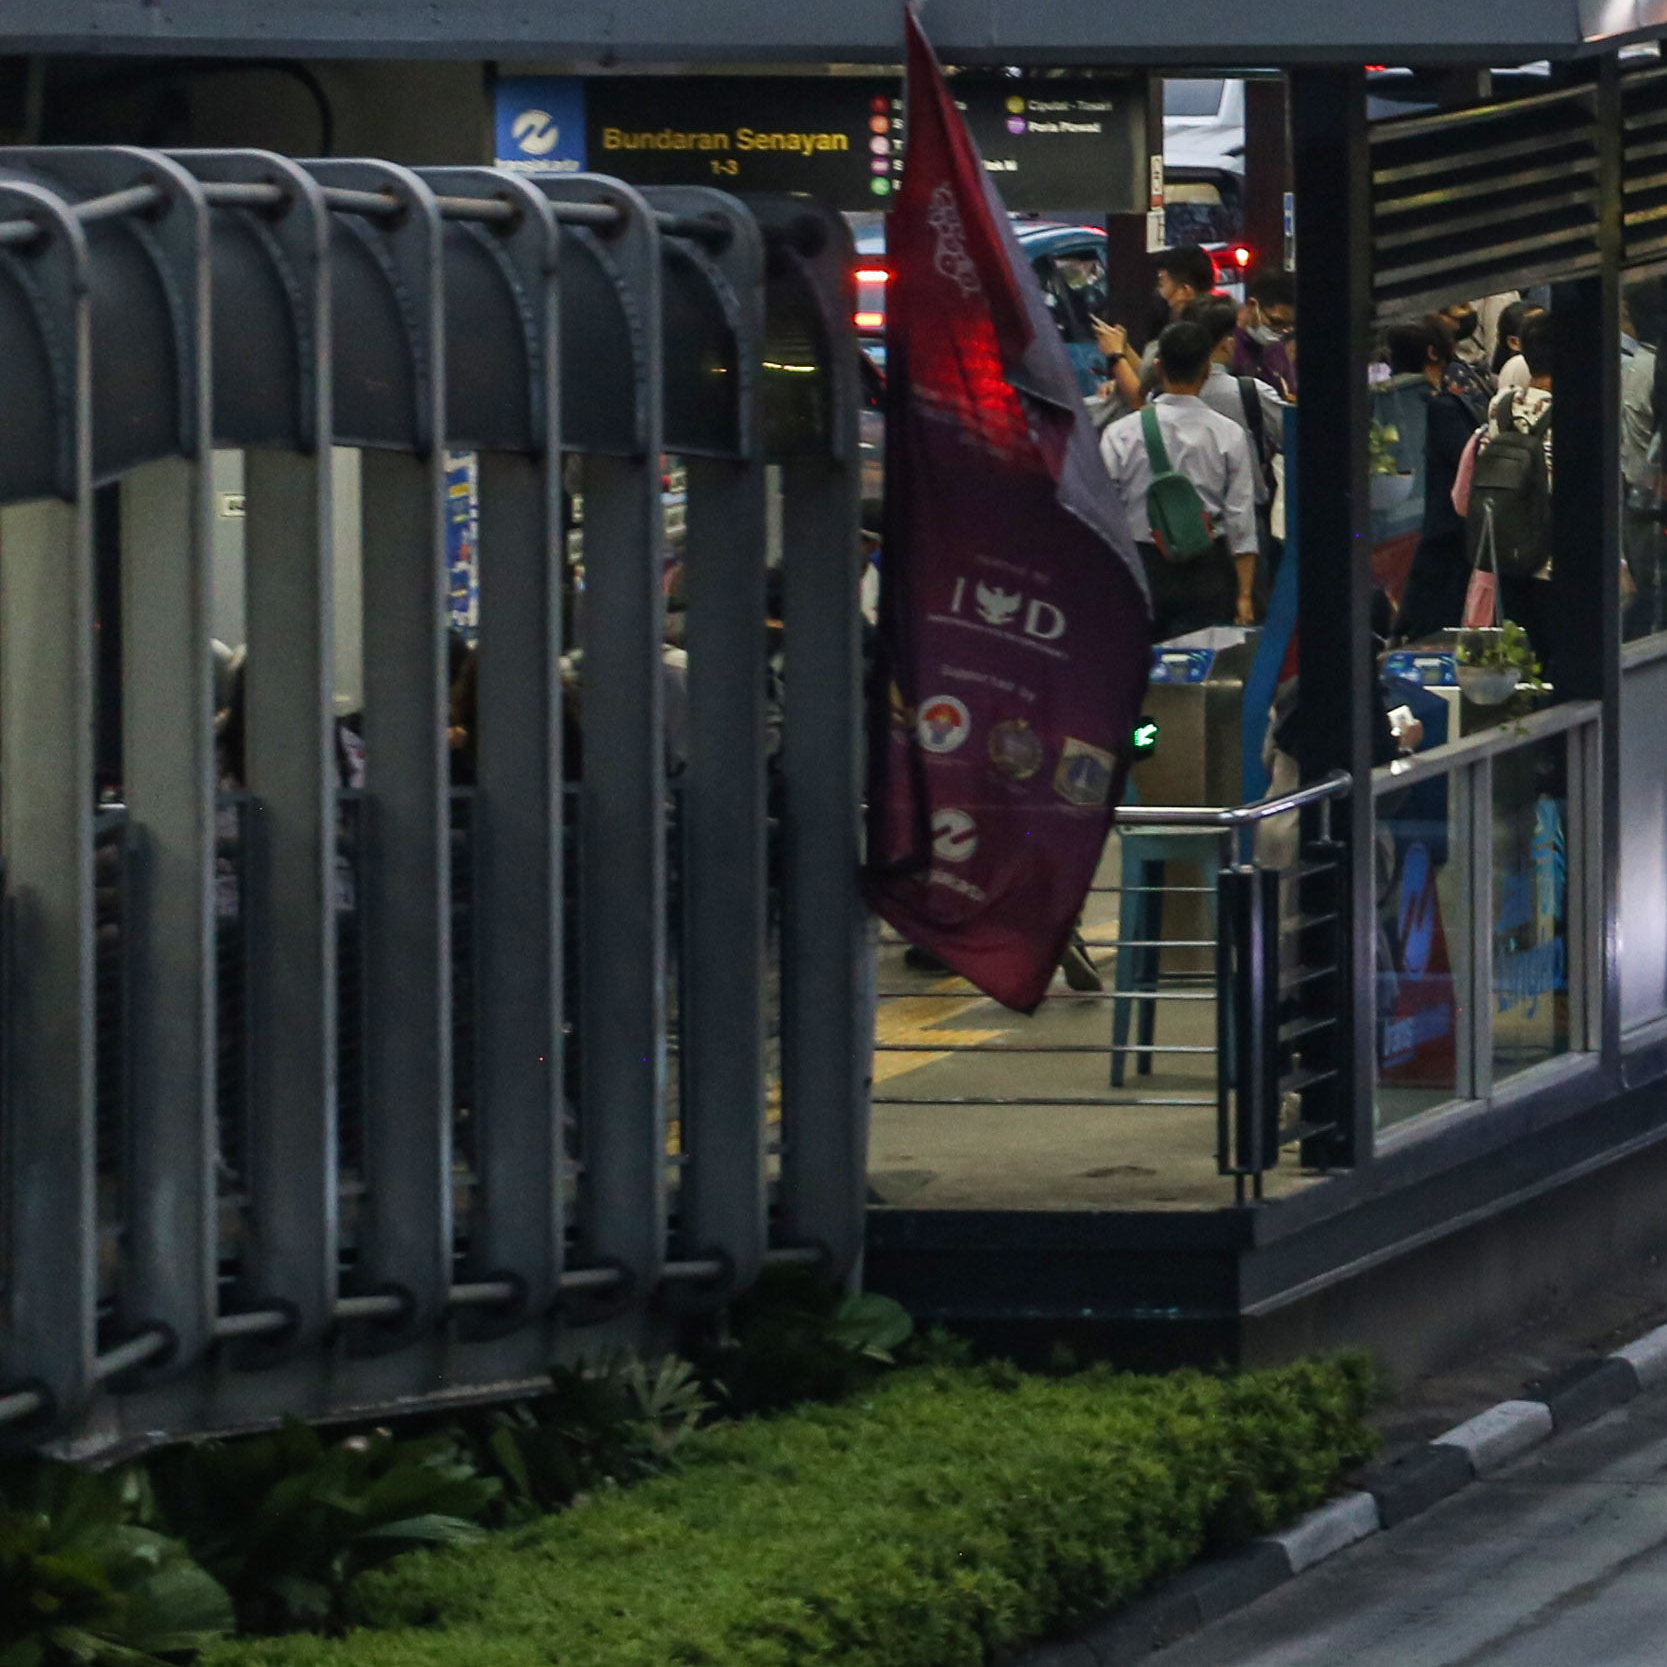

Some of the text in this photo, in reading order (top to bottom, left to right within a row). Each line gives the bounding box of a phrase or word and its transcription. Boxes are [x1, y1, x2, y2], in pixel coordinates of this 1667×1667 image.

[603, 127, 848, 156] Bundaran Senayan
[709, 159, 740, 175] 1-3
